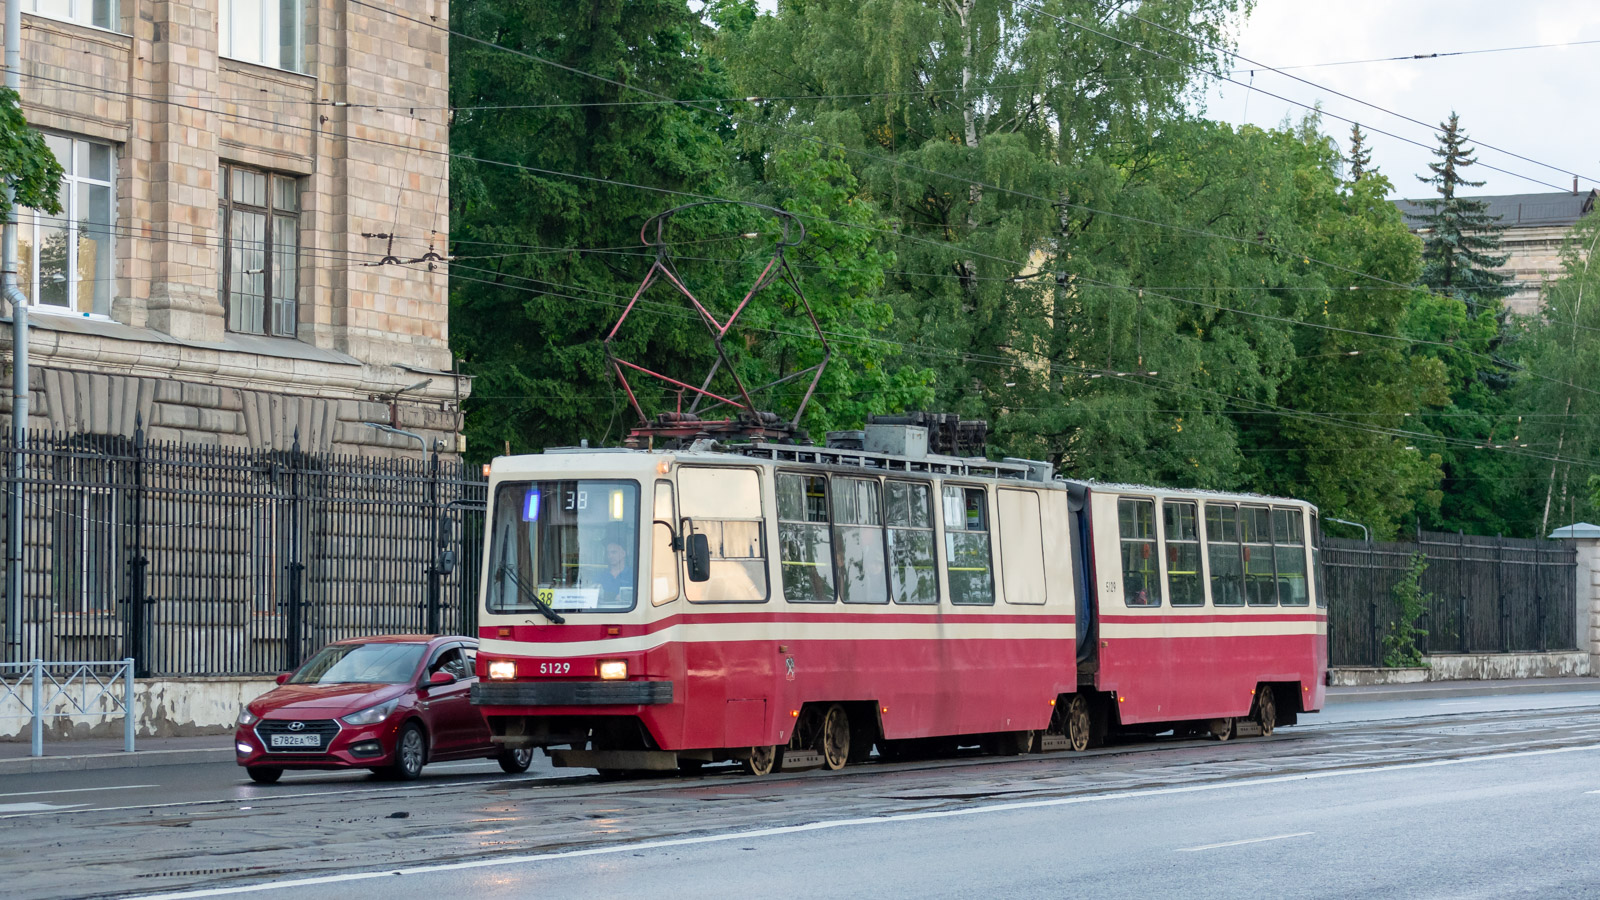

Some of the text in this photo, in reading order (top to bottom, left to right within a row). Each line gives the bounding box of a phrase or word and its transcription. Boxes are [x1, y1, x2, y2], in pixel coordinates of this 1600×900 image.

[565, 491, 588, 510] 38
[539, 592, 553, 607] 38
[539, 662, 571, 675] 5129
[273, 735, 304, 745] Е782ЕА
